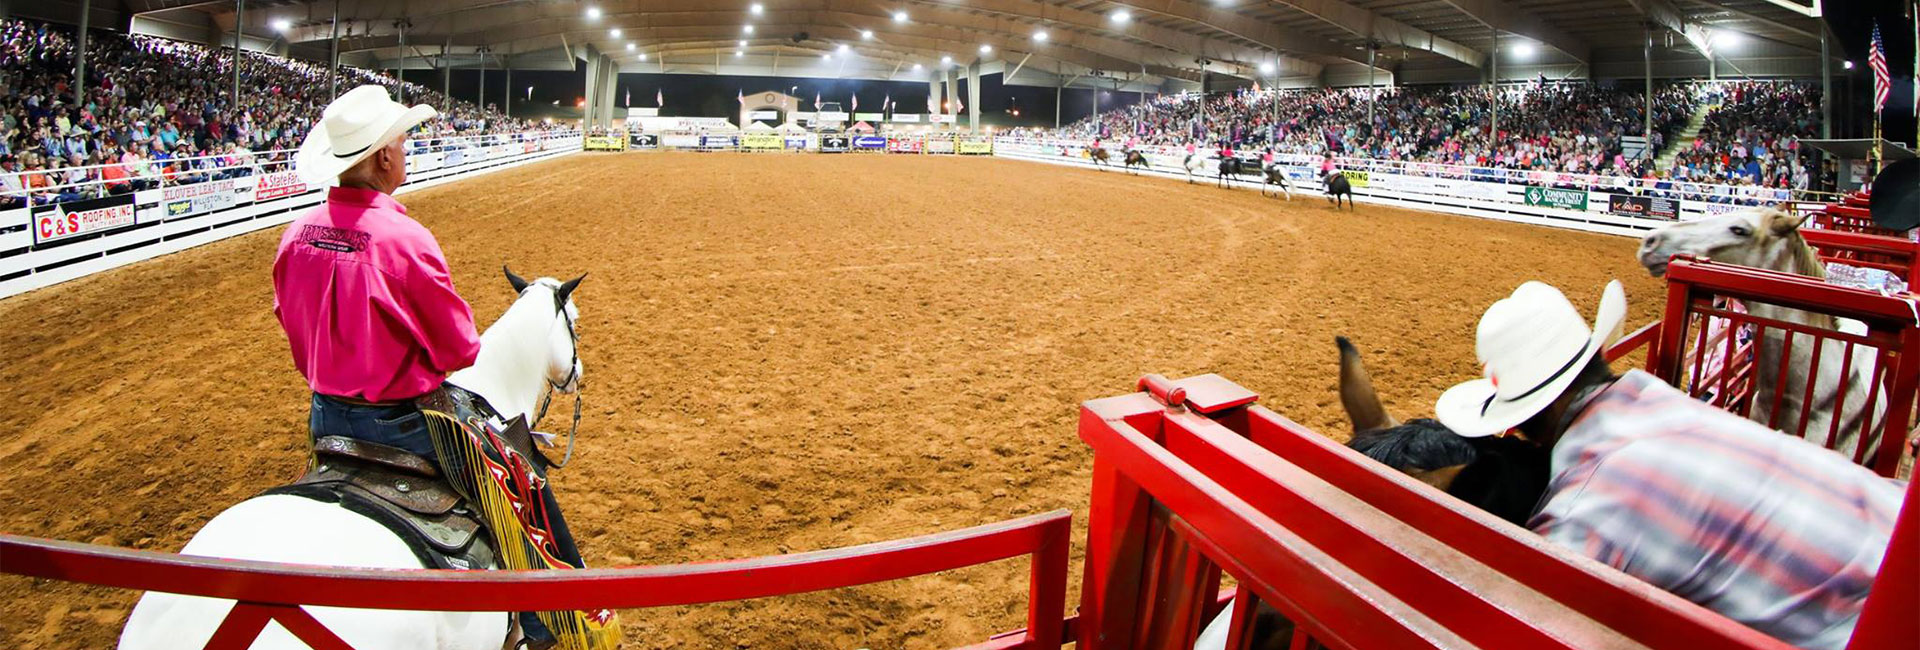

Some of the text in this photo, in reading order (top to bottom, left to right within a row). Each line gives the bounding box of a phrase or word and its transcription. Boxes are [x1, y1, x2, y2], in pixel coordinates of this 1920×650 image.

[164, 186, 198, 201] KLOVER
[197, 183, 217, 197] LEAF
[1543, 189, 1585, 203] COMMUNITY
[82, 205, 133, 224] ROOFING INC.
[40, 212, 79, 238] C & S
